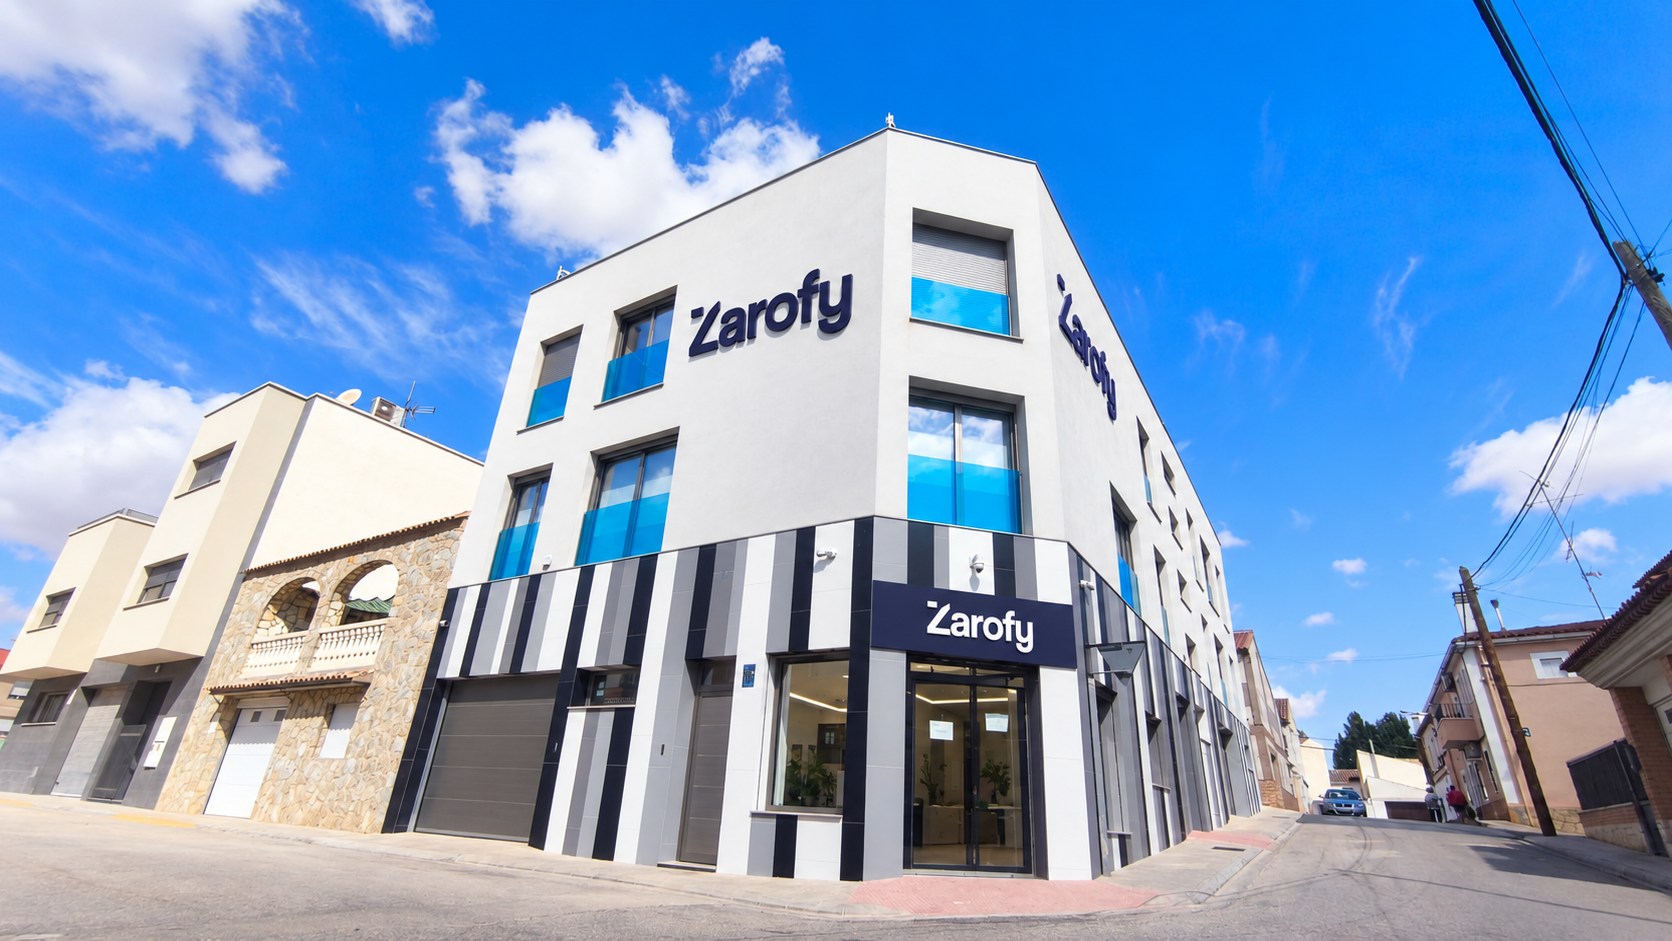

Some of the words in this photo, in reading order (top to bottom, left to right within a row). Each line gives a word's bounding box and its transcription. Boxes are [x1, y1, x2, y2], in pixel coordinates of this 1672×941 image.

[689, 268, 853, 357] Zarofy
[1056, 273, 1118, 421] Zarofy
[926, 599, 1035, 654] Zarofy
